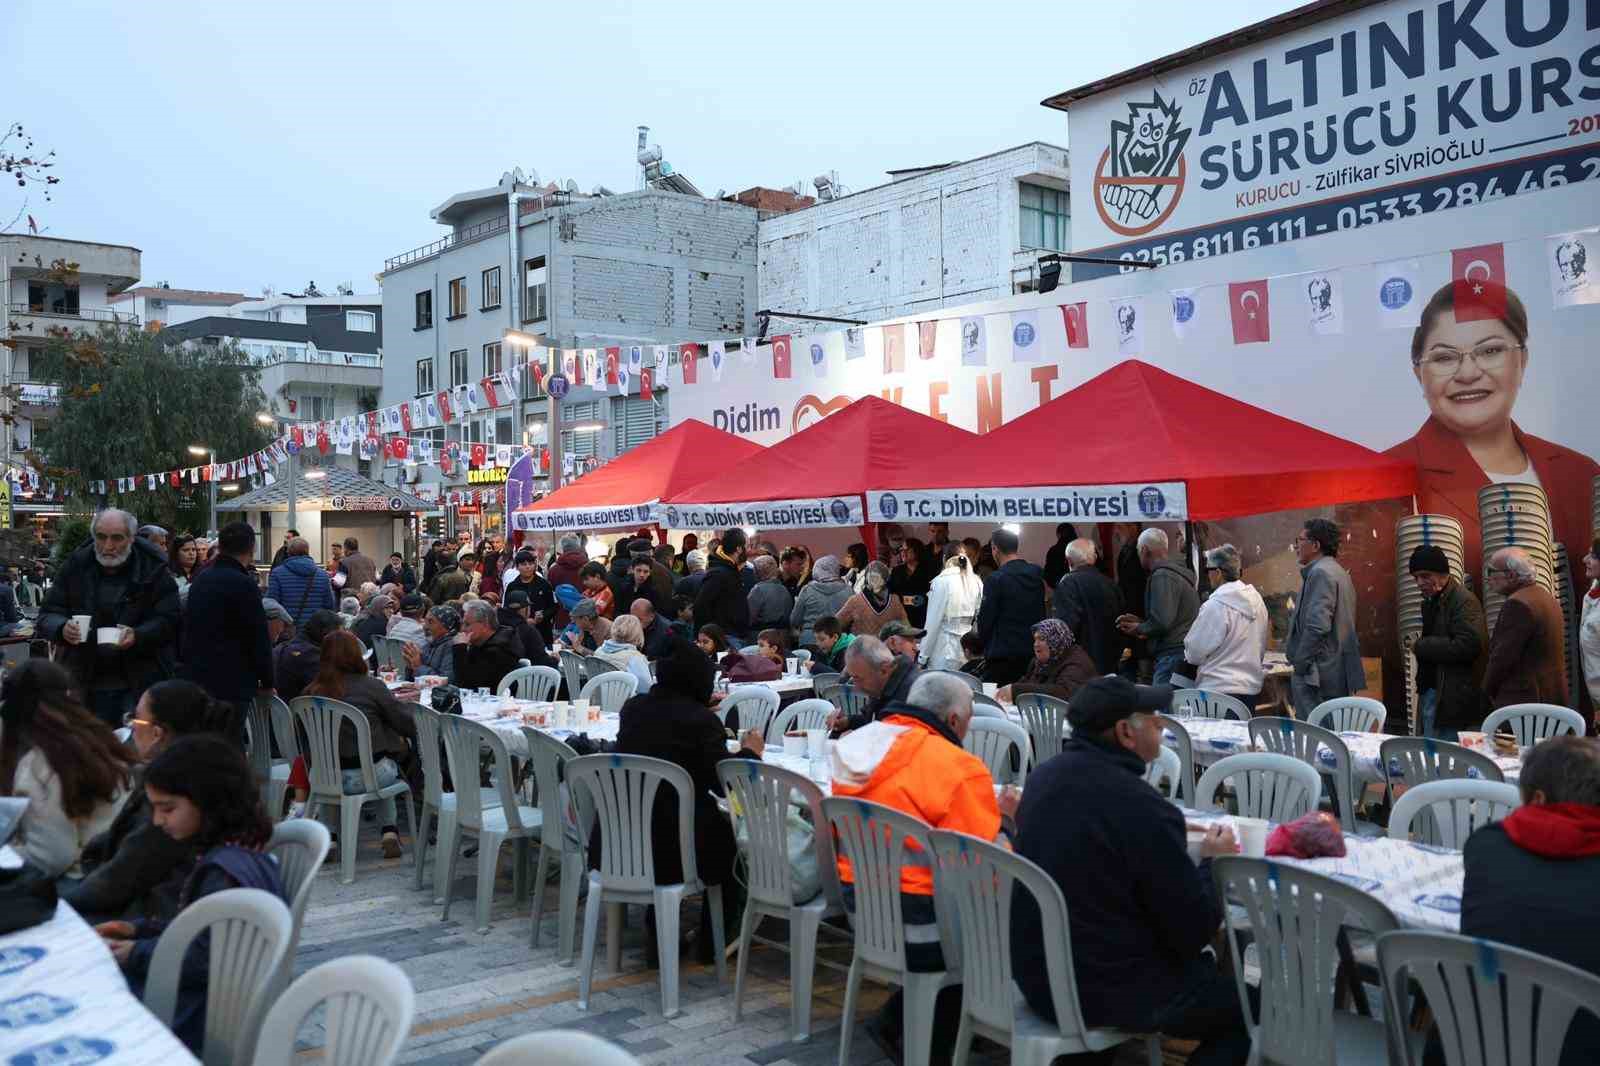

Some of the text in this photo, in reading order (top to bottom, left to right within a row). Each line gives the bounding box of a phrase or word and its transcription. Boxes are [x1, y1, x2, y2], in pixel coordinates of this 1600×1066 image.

[1188, 79, 1207, 97] ÖZ
[1199, 94, 1416, 190] SÜRÜCÜ
[1235, 179, 1301, 208] KURUCU
[1315, 165, 1381, 191] Zülfikar
[1384, 138, 1485, 177] SİVRİOĞLU
[1192, 231, 1235, 261] 811
[1242, 226, 1261, 249] 6
[1267, 215, 1307, 242] 111
[1336, 193, 1424, 232] 0533
[1432, 177, 1507, 210] 284
[1515, 164, 1568, 196] 46
[713, 402, 781, 434] Didim
[682, 503, 828, 527] T.C. DİDİM BELEDİYESİ
[904, 490, 1129, 518] T.C. DİDİM BELEDİYESİ
[529, 516, 548, 529] T.C.
[547, 511, 575, 528] DİDİM
